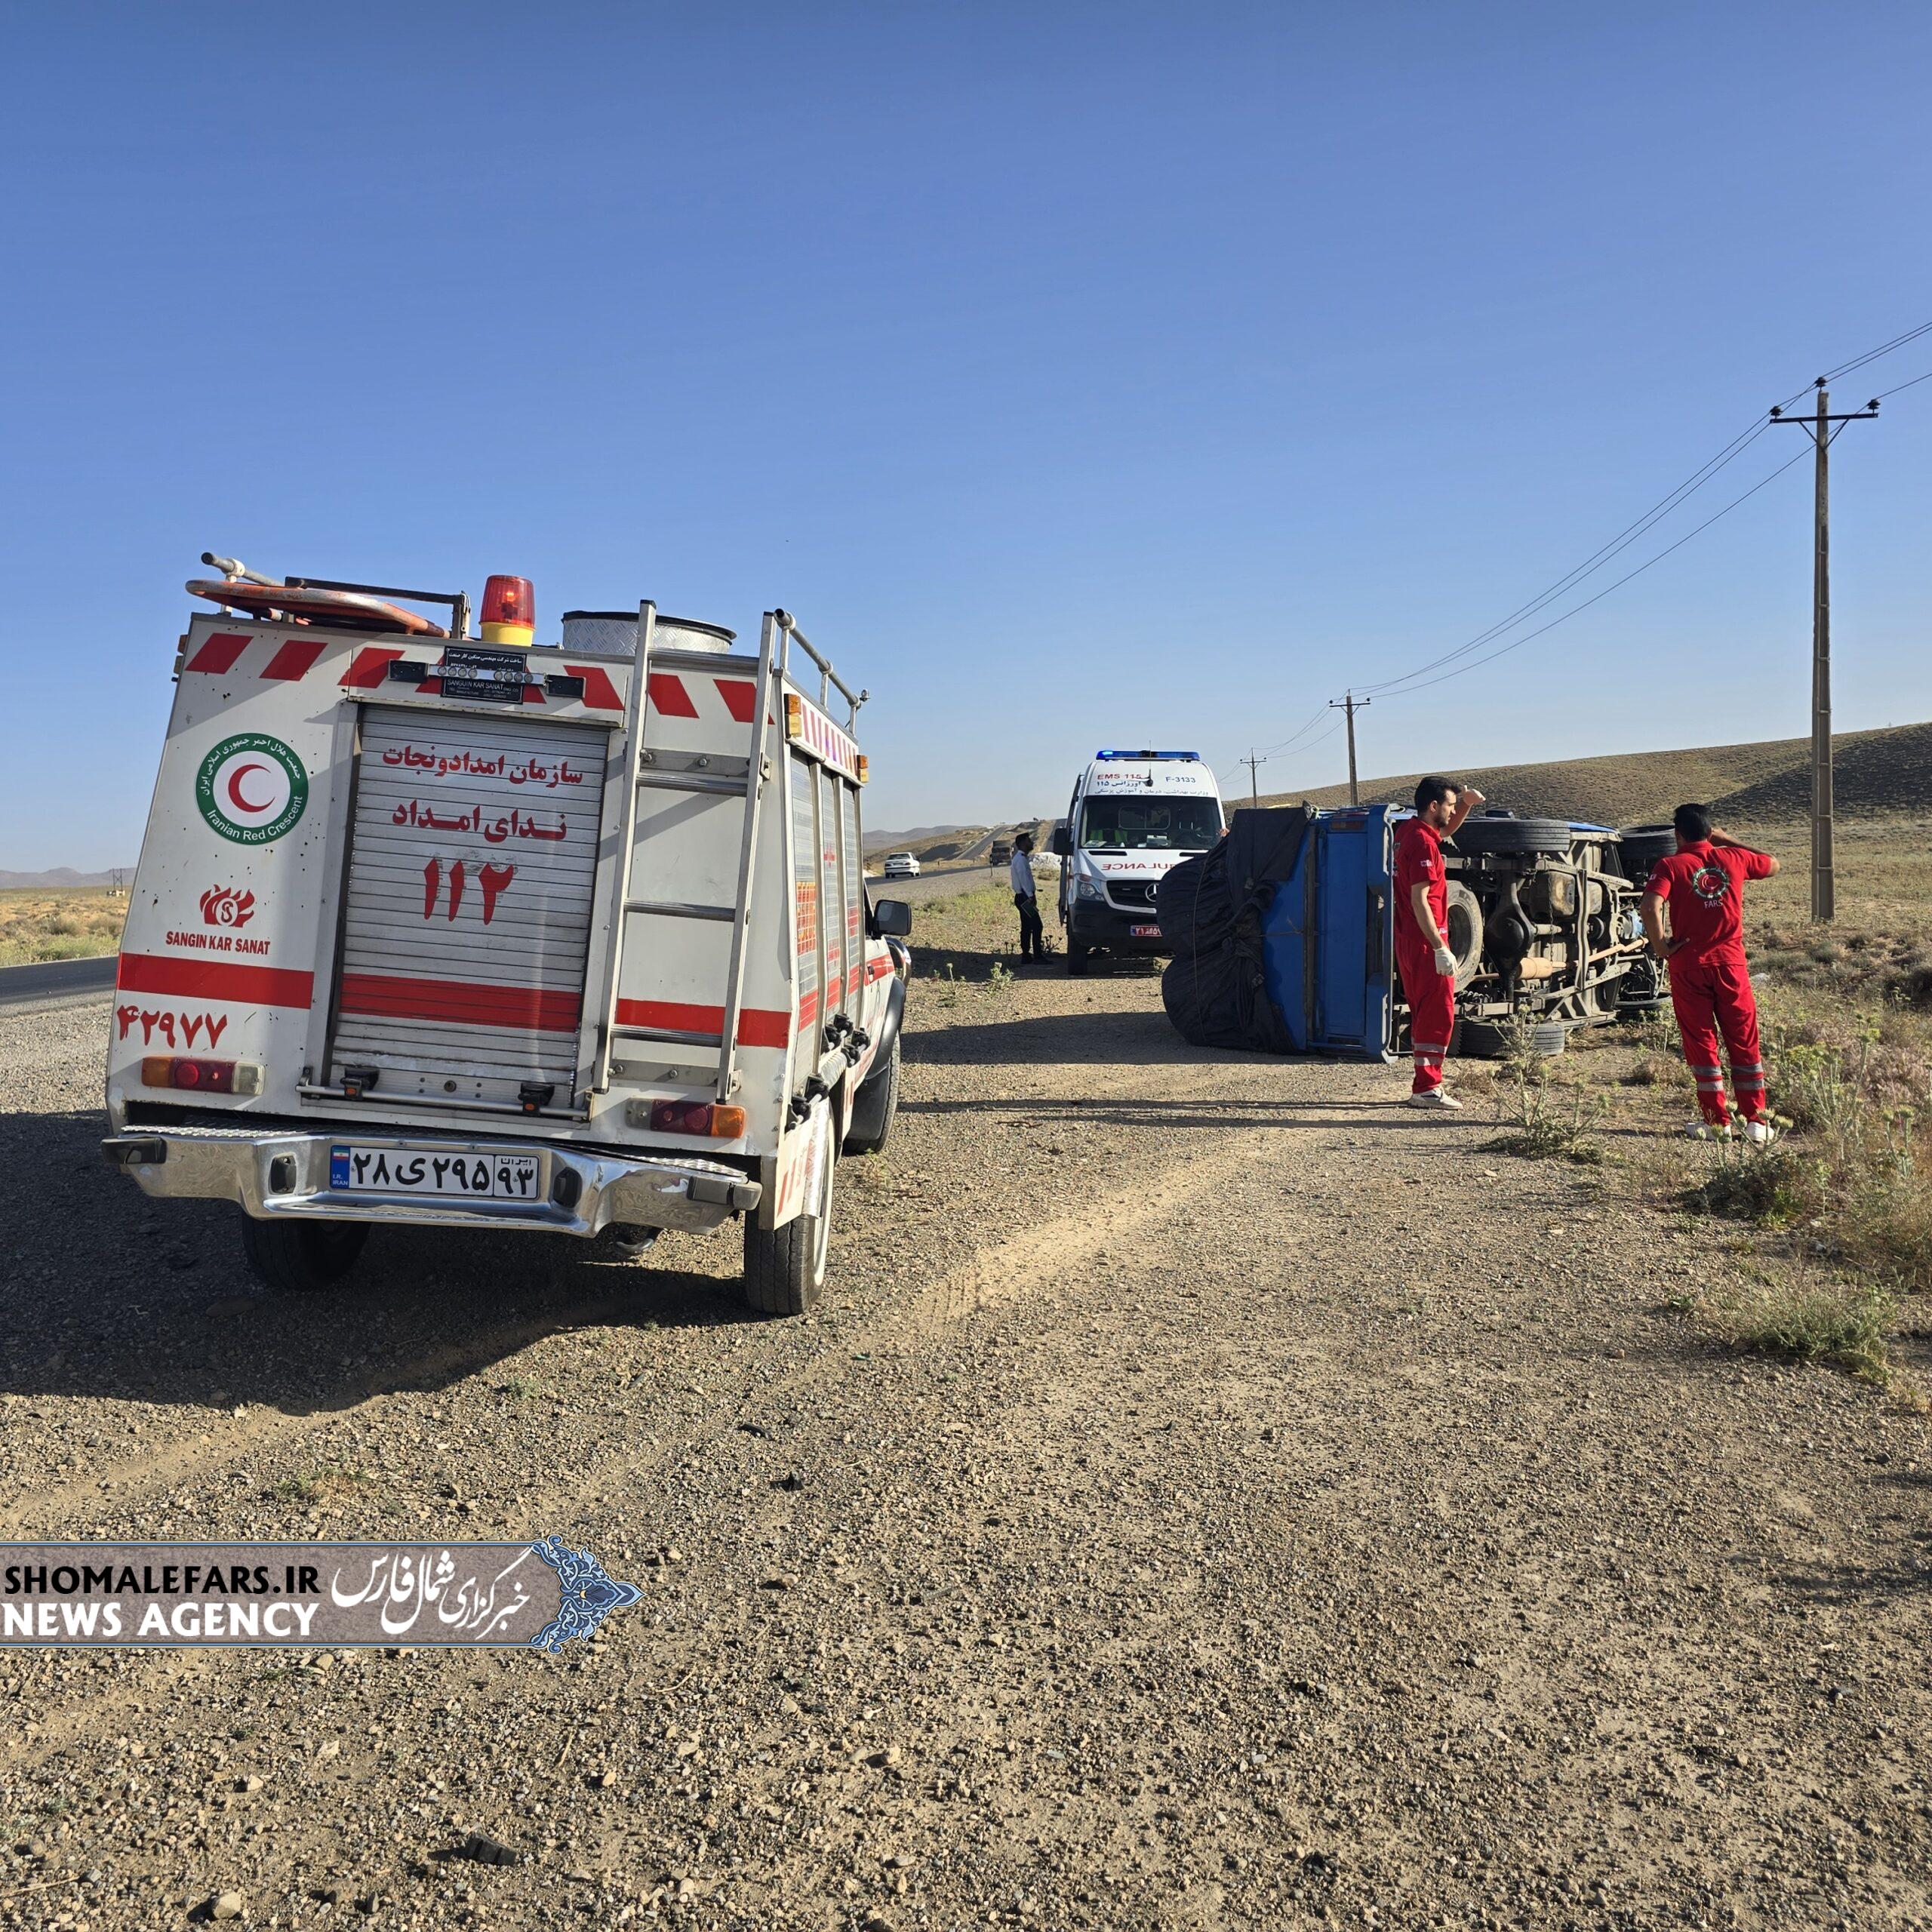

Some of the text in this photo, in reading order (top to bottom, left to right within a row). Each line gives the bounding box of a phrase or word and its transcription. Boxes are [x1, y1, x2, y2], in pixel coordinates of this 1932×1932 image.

[222, 738, 250, 754] جمهوری
[270, 743, 287, 756] هلال
[208, 750, 221, 776] اسلامی
[287, 756, 300, 780] جمعیت
[509, 758, 583, 787] سازمان
[201, 776, 211, 795] ایران
[208, 795, 303, 841] Iranian Red Crescent
[392, 799, 567, 842] ندای امداد
[424, 857, 514, 925] ۱۱۲
[1704, 899, 1723, 909] FARS
[166, 931, 270, 955] SANGIN KAR SANAT
[117, 1005, 227, 1049] ۴۲۹۷۷
[500, 1157, 531, 1167] ایران
[497, 1167, 534, 1195] ۹۳
